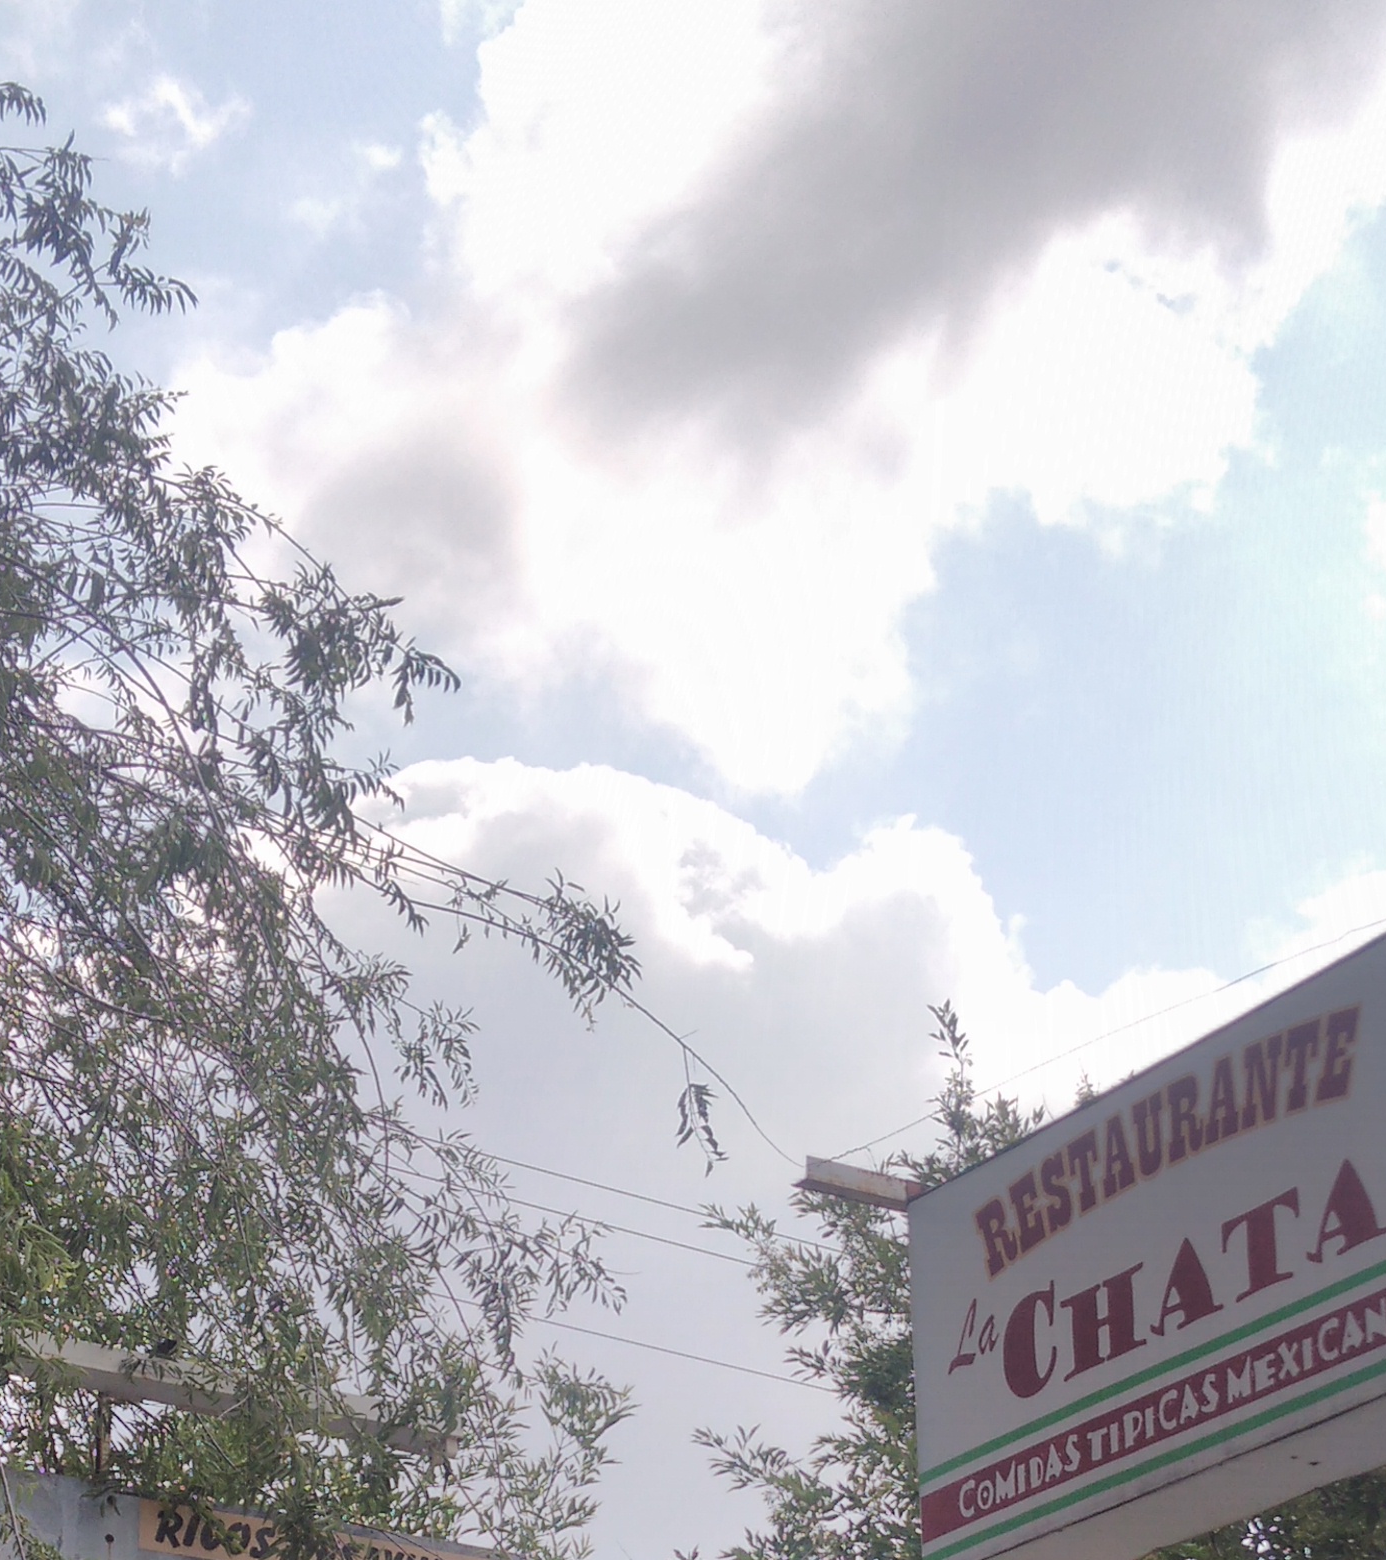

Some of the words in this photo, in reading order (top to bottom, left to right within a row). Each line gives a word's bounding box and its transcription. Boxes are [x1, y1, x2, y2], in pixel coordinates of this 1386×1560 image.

[973, 1004, 1362, 1282] RESTAURANTE
[948, 1298, 1001, 1376] La
[958, 1433, 1082, 1519] COMIDAS
[1086, 1371, 1221, 1464] TIPICAS
